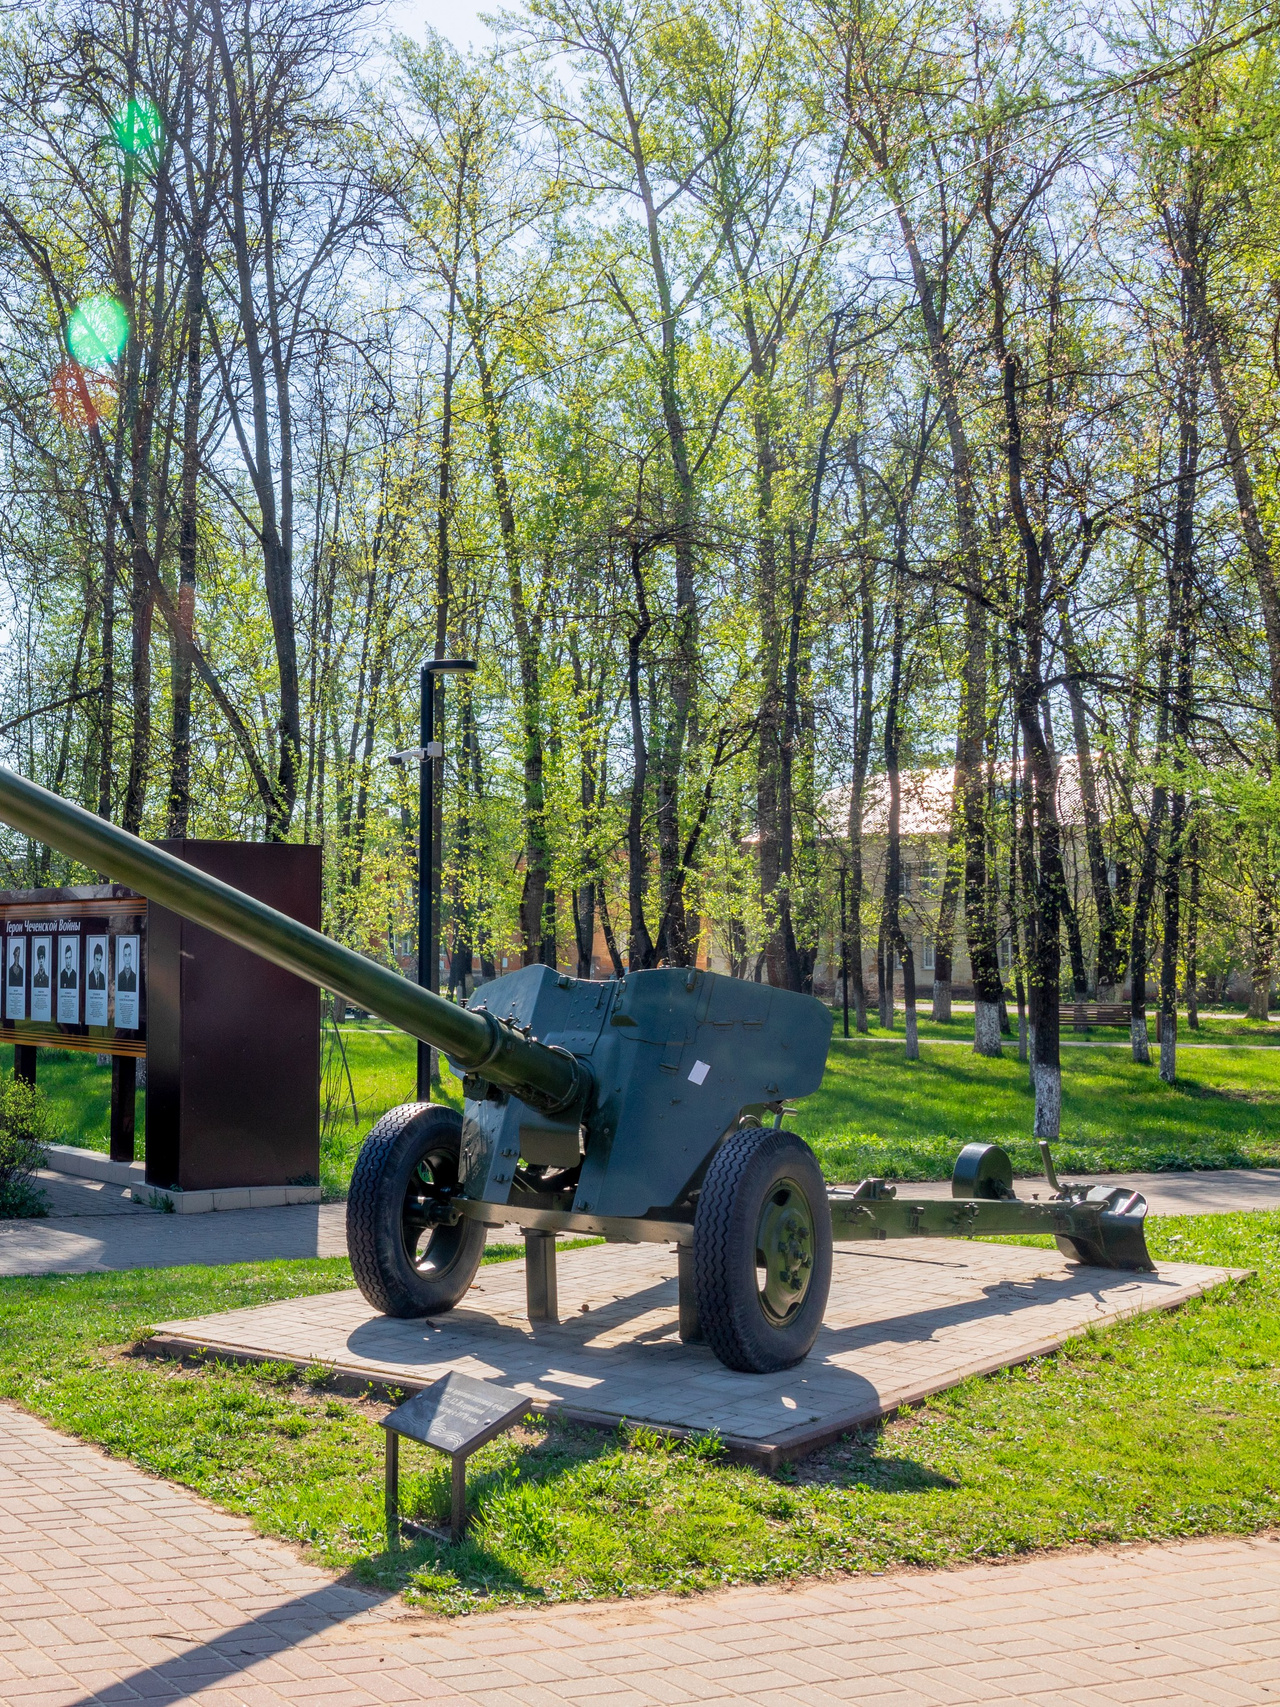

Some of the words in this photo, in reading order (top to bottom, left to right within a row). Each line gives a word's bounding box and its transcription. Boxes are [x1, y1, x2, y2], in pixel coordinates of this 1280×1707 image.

[6, 921, 23, 936] Герои
[24, 920, 58, 932] Чеченской
[58, 919, 81, 931] Войны
